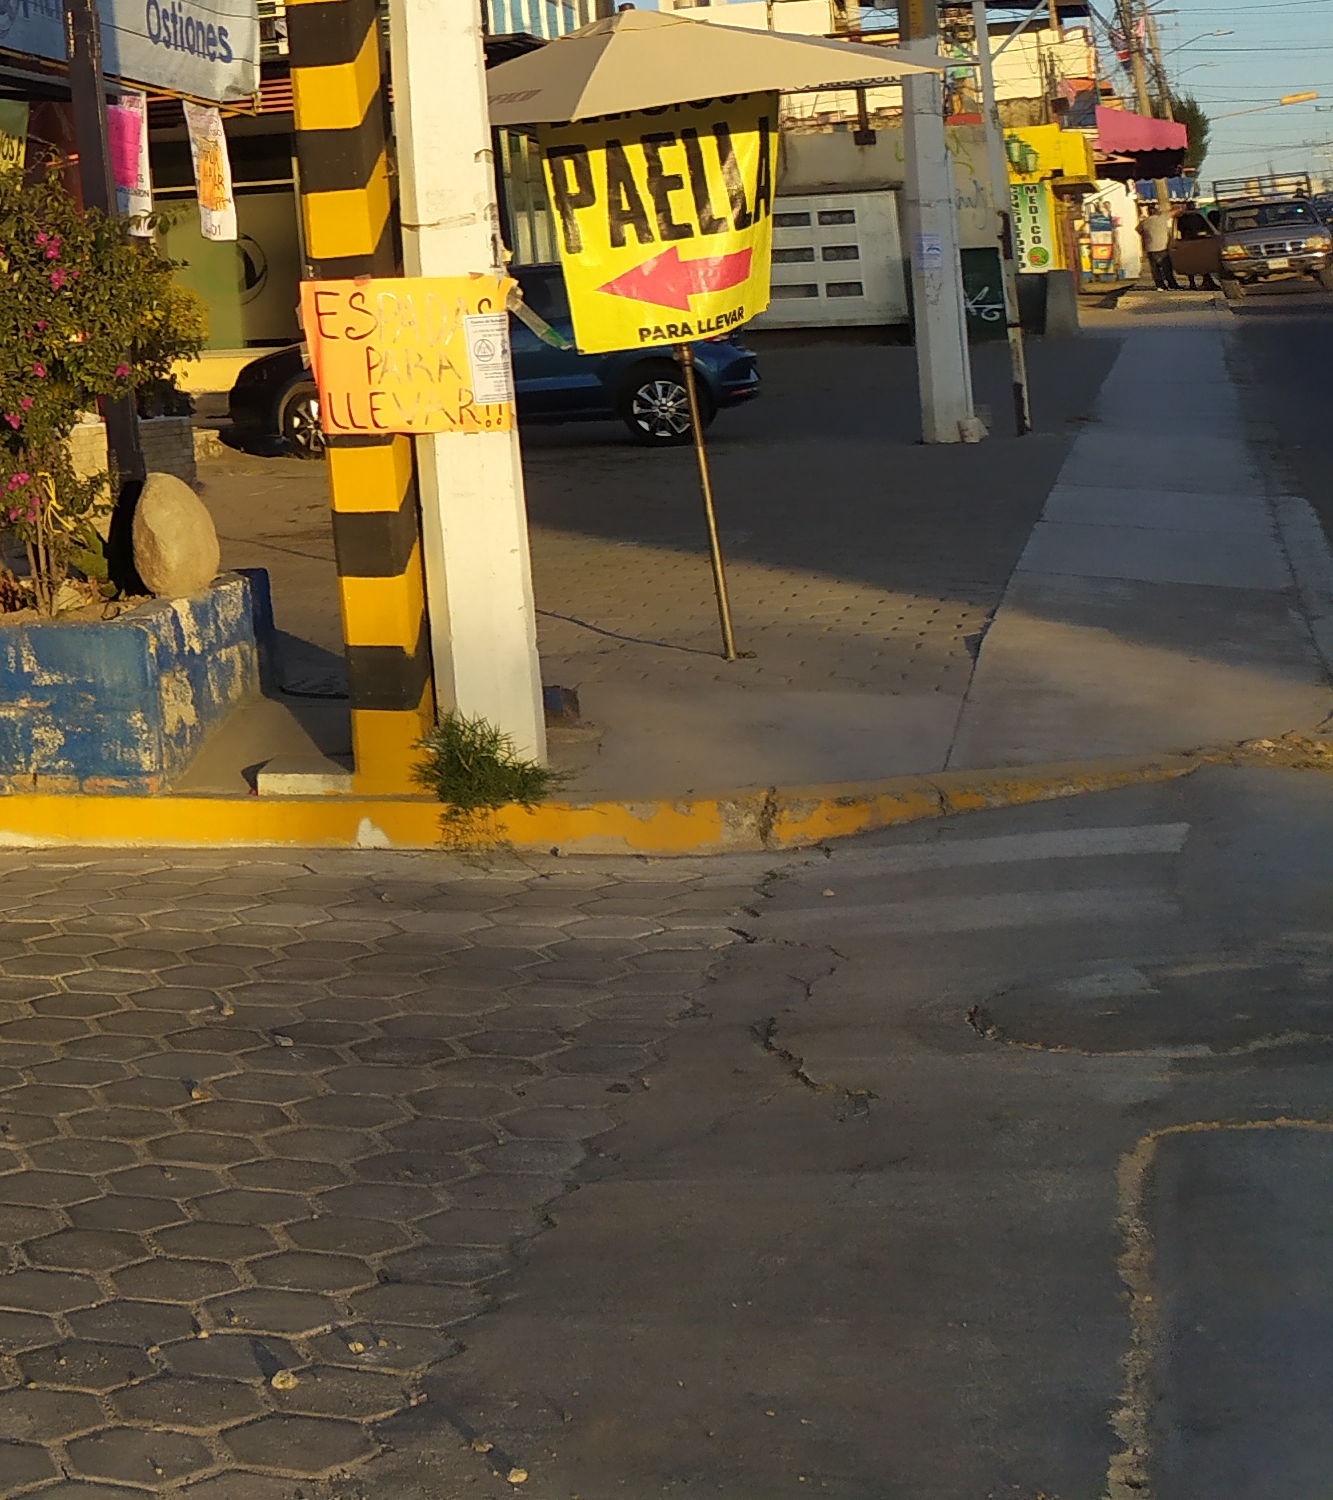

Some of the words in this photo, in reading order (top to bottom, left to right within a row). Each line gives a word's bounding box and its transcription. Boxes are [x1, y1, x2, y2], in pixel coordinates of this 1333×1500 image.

[545, 116, 771, 255] PAELLA
[1024, 186, 1043, 245] MEDICO
[638, 321, 694, 343] PARA
[696, 306, 745, 334] LLEVAR
[365, 345, 462, 386] PARA
